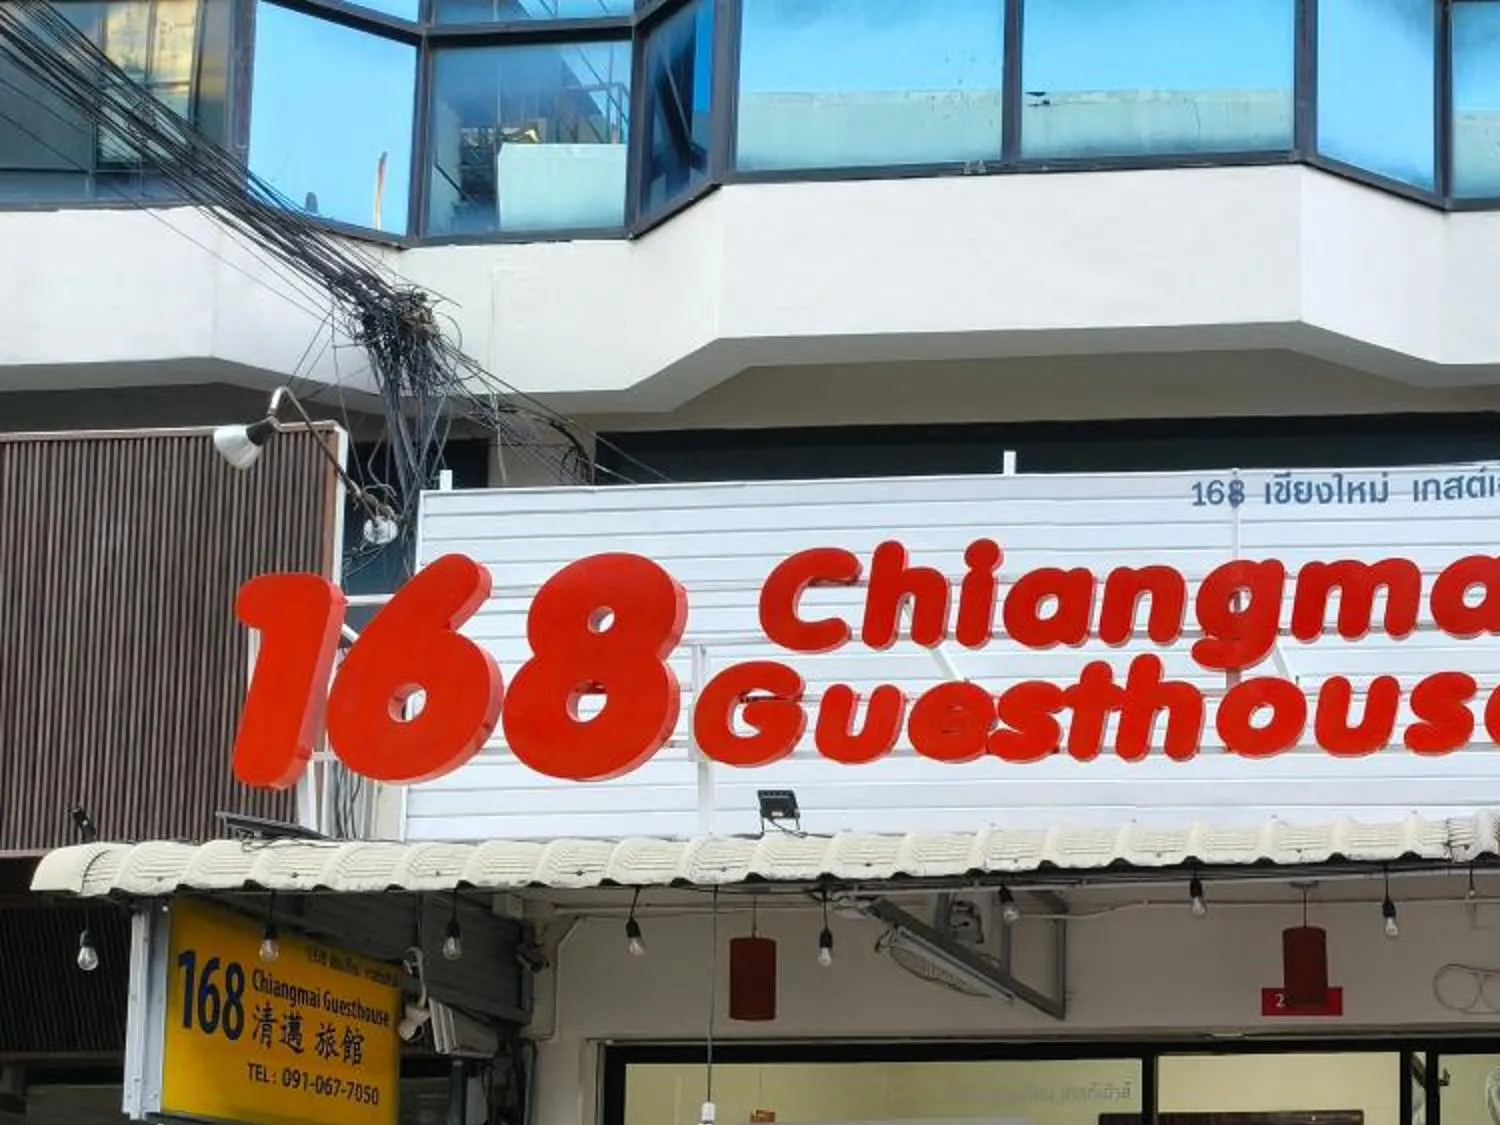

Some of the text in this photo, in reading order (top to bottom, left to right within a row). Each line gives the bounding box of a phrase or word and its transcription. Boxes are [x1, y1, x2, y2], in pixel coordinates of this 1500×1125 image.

[1191, 479, 1246, 508] 168
[232, 551, 689, 790] 168
[178, 950, 245, 1041] 168
[252, 968, 321, 1008] Chiangmai
[323, 992, 390, 1027] Guesthouse
